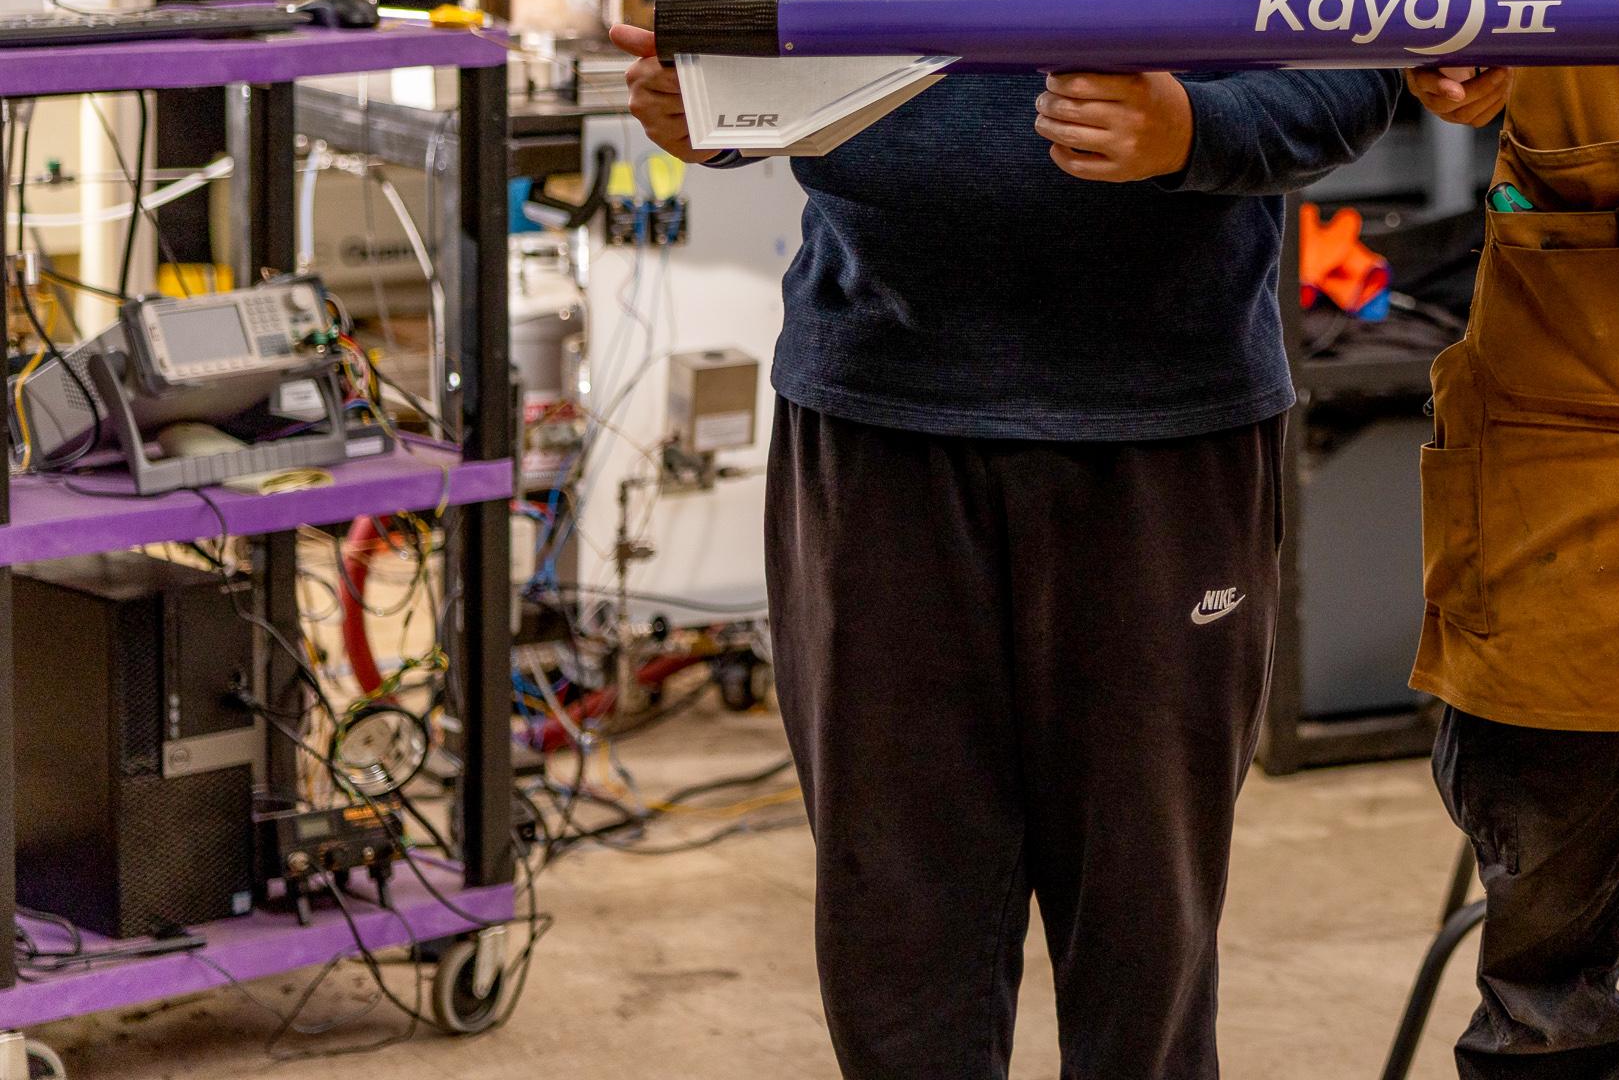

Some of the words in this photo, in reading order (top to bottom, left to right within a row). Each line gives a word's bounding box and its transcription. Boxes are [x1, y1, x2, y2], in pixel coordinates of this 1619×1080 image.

[1491, 0, 1562, 33] II
[717, 113, 779, 128] LSR
[1201, 586, 1237, 611] NIKE
